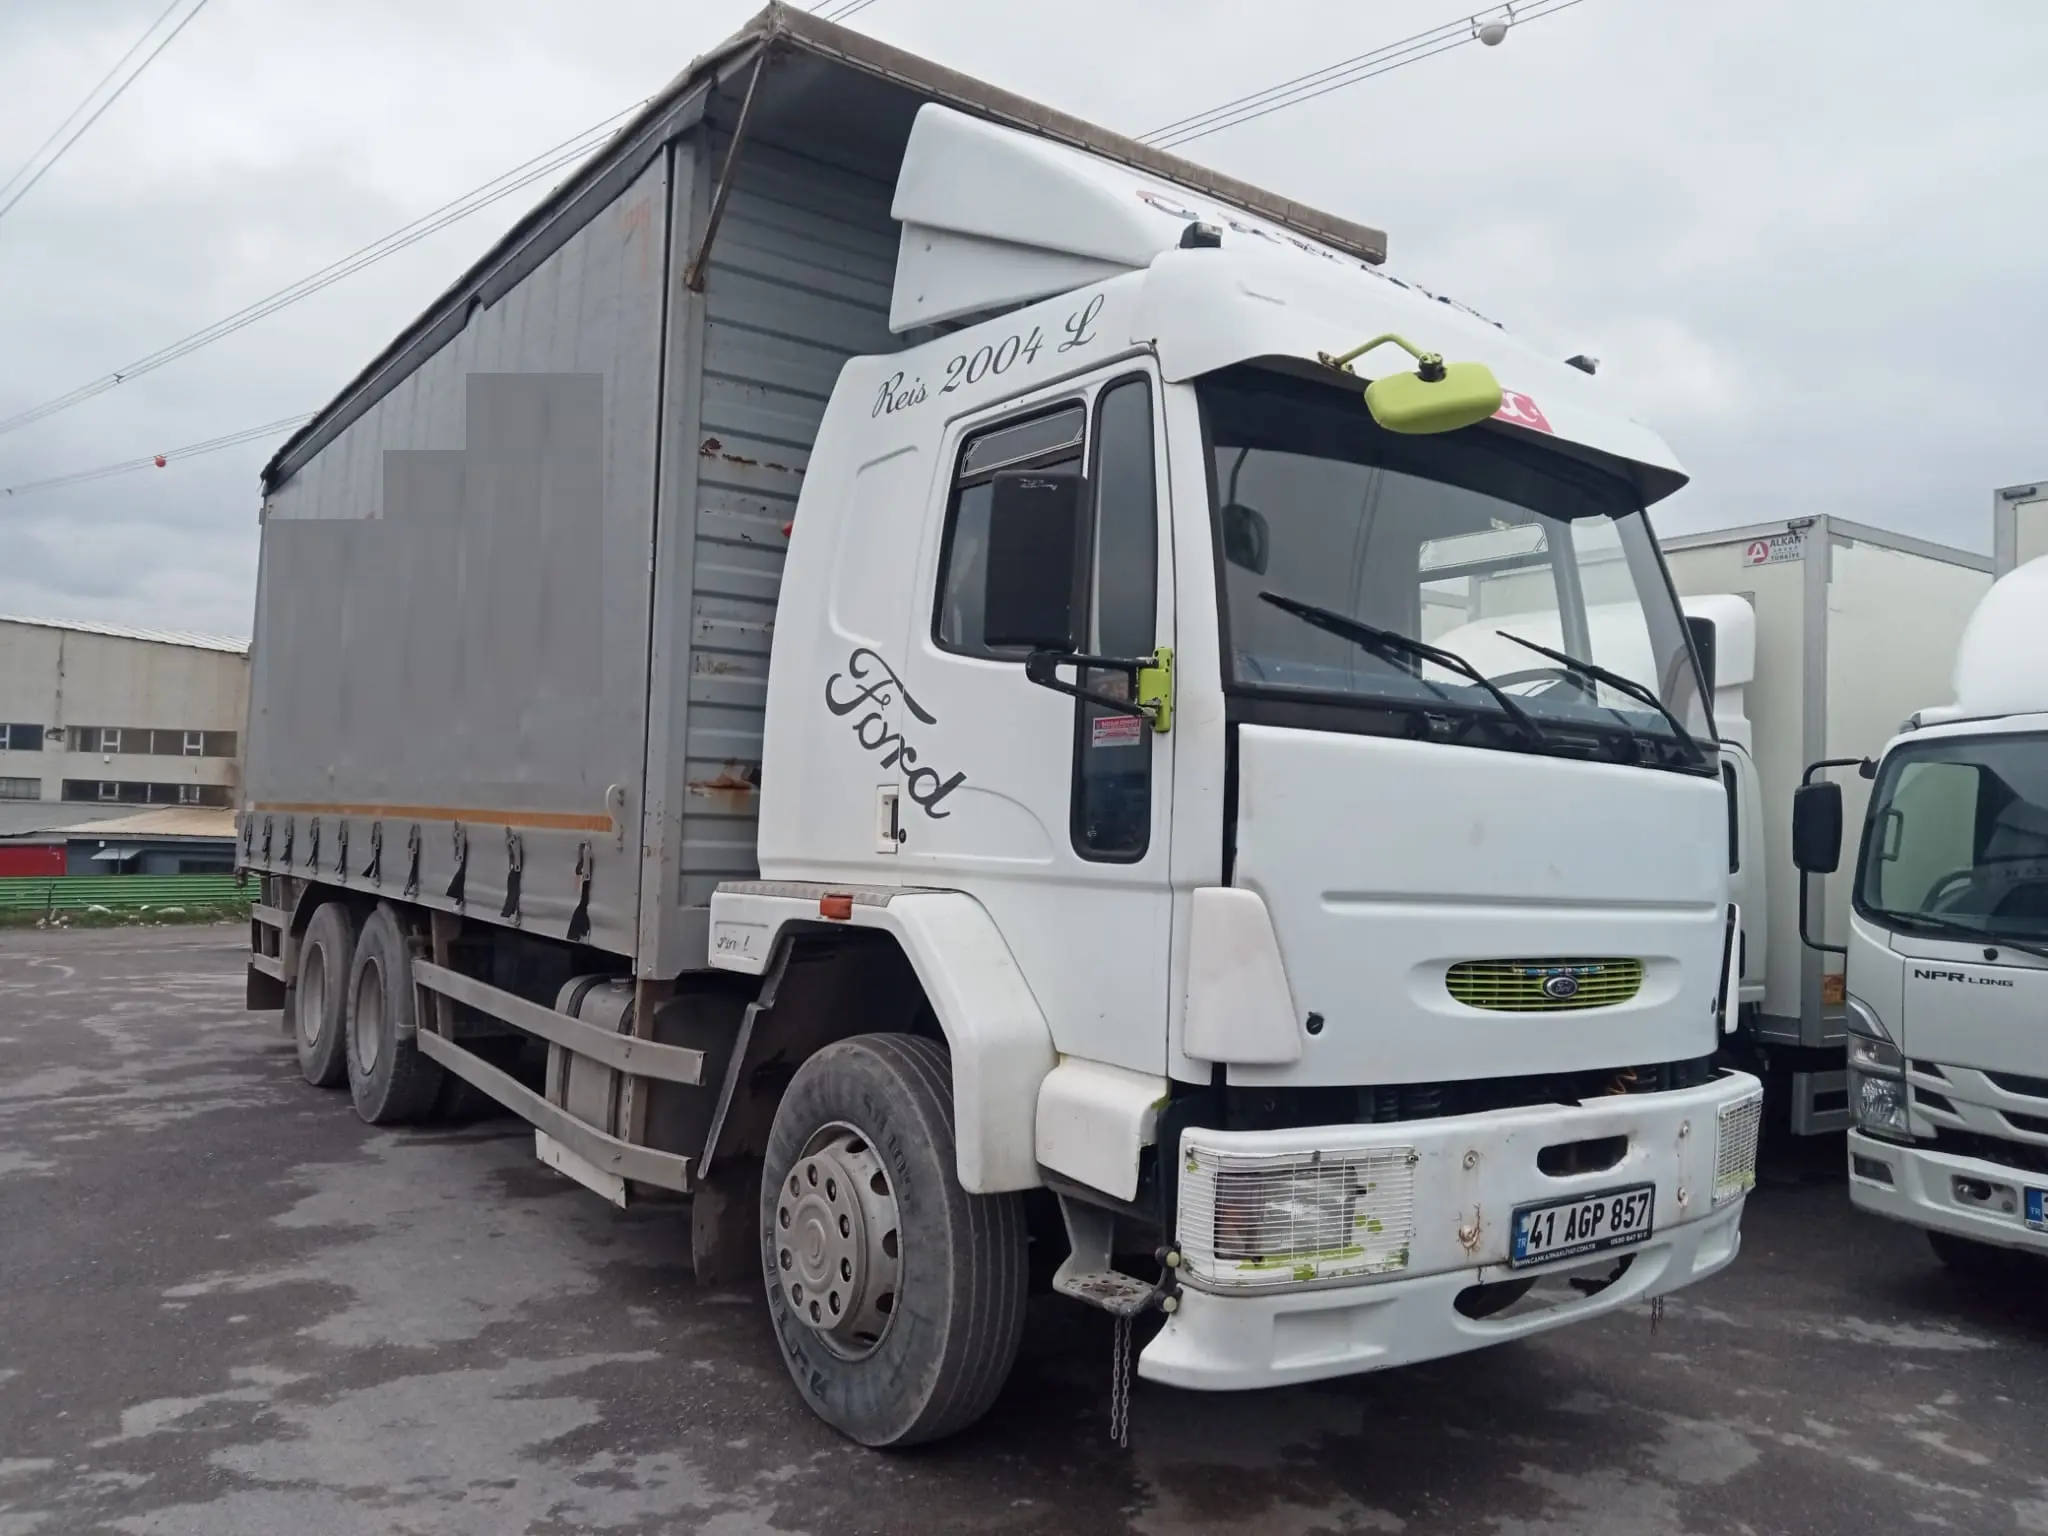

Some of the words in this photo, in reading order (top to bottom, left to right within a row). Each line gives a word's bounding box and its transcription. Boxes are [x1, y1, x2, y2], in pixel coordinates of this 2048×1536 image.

[872, 371, 928, 418] Reis
[939, 326, 1044, 392] 2004
[1770, 535, 1802, 548] ALKAN
[825, 648, 967, 819] Ford
[1914, 969, 1965, 983] NPR
[1968, 977, 2014, 987] LONG
[1529, 1211, 1556, 1249] 41
[1564, 1203, 1605, 1242] AGP
[1610, 1192, 1650, 1232] 857
[1517, 1237, 1527, 1249] TR
